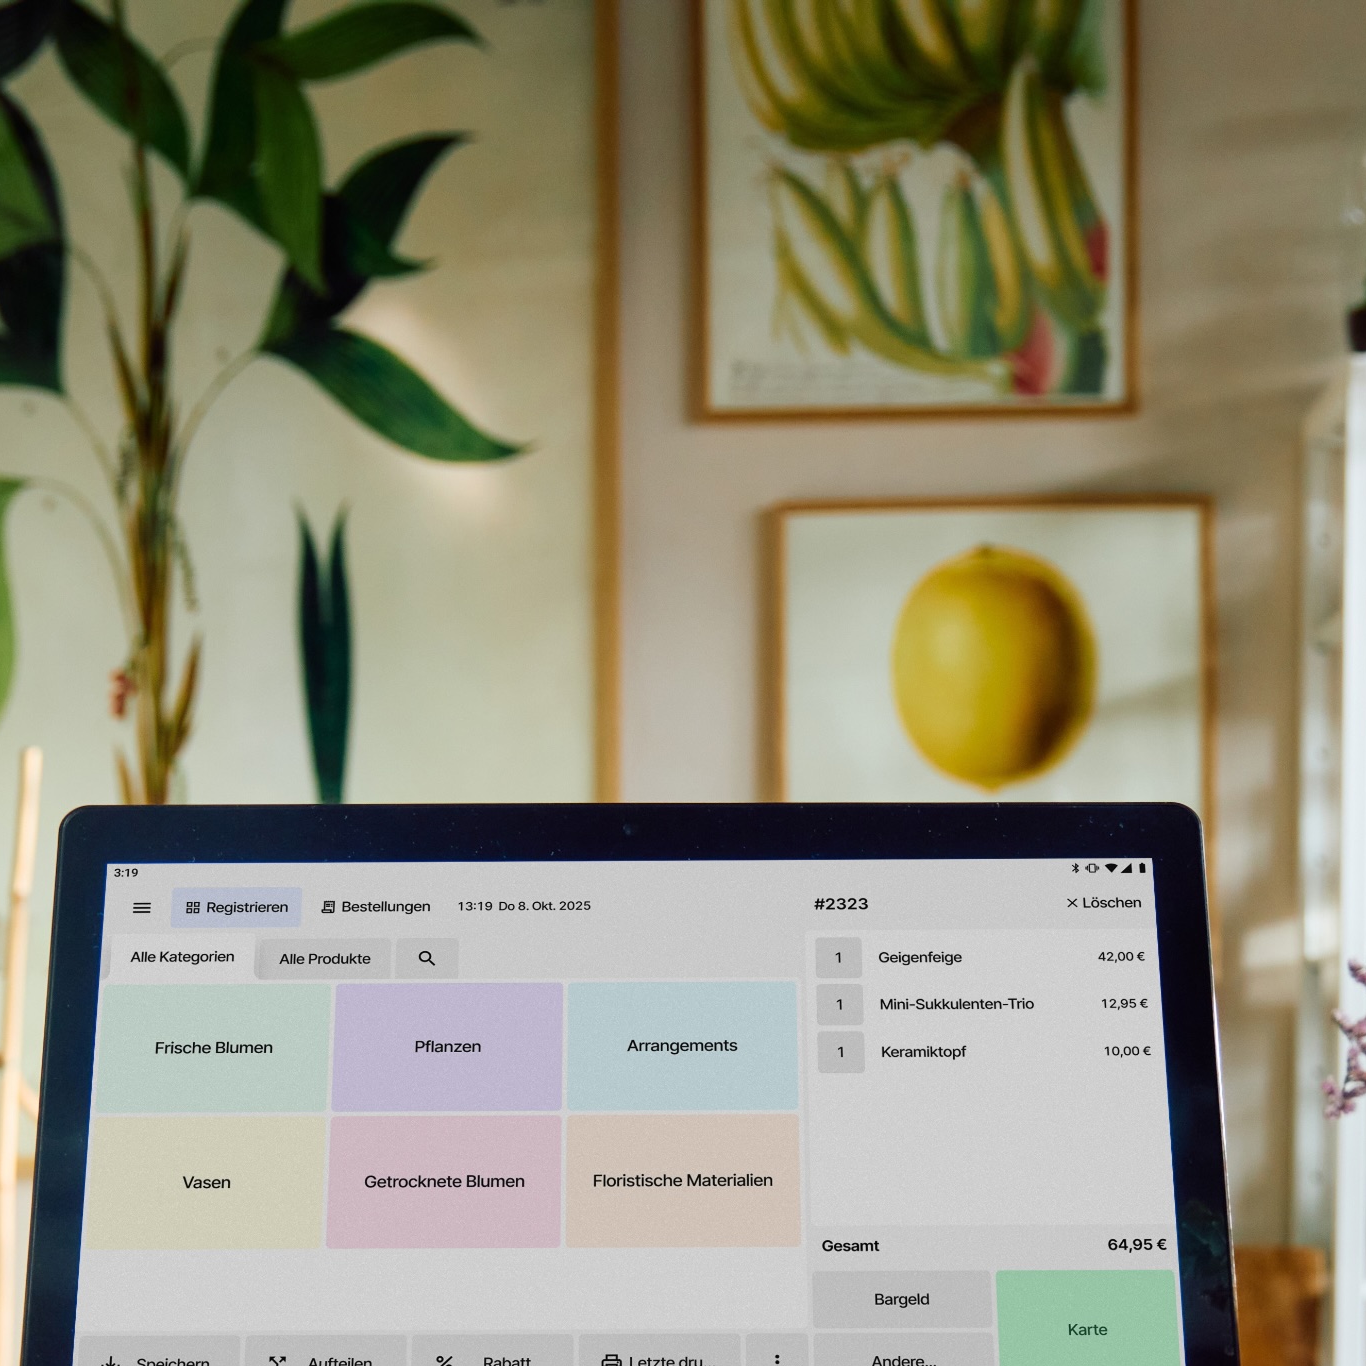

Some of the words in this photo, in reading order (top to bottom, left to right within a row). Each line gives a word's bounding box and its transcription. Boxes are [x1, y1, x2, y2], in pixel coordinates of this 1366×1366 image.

[113, 867, 139, 878] 3:19
[206, 901, 289, 916] Registrieren
[341, 900, 431, 915] Bestellungen
[458, 901, 493, 912] 13:19
[498, 901, 516, 911] Do
[517, 901, 530, 911] 8.
[531, 900, 556, 911] Okt.
[559, 900, 591, 911] 2025
[813, 897, 869, 911] #2323
[1082, 896, 1142, 909] Löschen
[130, 951, 157, 963] Alle
[159, 950, 235, 966] Kategorien
[278, 953, 305, 965] Alle
[308, 953, 371, 965] Produkte
[835, 951, 842, 964] 1
[878, 950, 963, 966] Geigenfeige
[1097, 951, 1134, 964] 42,00
[1136, 951, 1146, 962] €
[836, 998, 843, 1011] 1
[880, 997, 1035, 1010] Mini-Sukkulenten-Trio
[1101, 998, 1137, 1011] 12,95
[1139, 998, 1149, 1009] €
[155, 1041, 212, 1055] Frische
[215, 1041, 273, 1054] Blumen
[414, 1039, 482, 1053] Pflanzen
[626, 1039, 738, 1056] Arrangements
[837, 1046, 844, 1058] 1
[881, 1045, 967, 1061] Keramiktopf
[1104, 1045, 1140, 1059] 10,00
[1142, 1045, 1152, 1056] €
[182, 1175, 231, 1190] Vasen
[364, 1174, 463, 1189] Getrocknete
[466, 1174, 525, 1188] Blumen
[593, 1173, 683, 1188] Floristische
[686, 1172, 773, 1187] Materialien
[821, 1239, 880, 1252] Gesamt
[1107, 1238, 1153, 1254] 64,95
[1156, 1238, 1168, 1251] €
[874, 1292, 930, 1309] Bargeld
[1068, 1323, 1108, 1336] Karte
